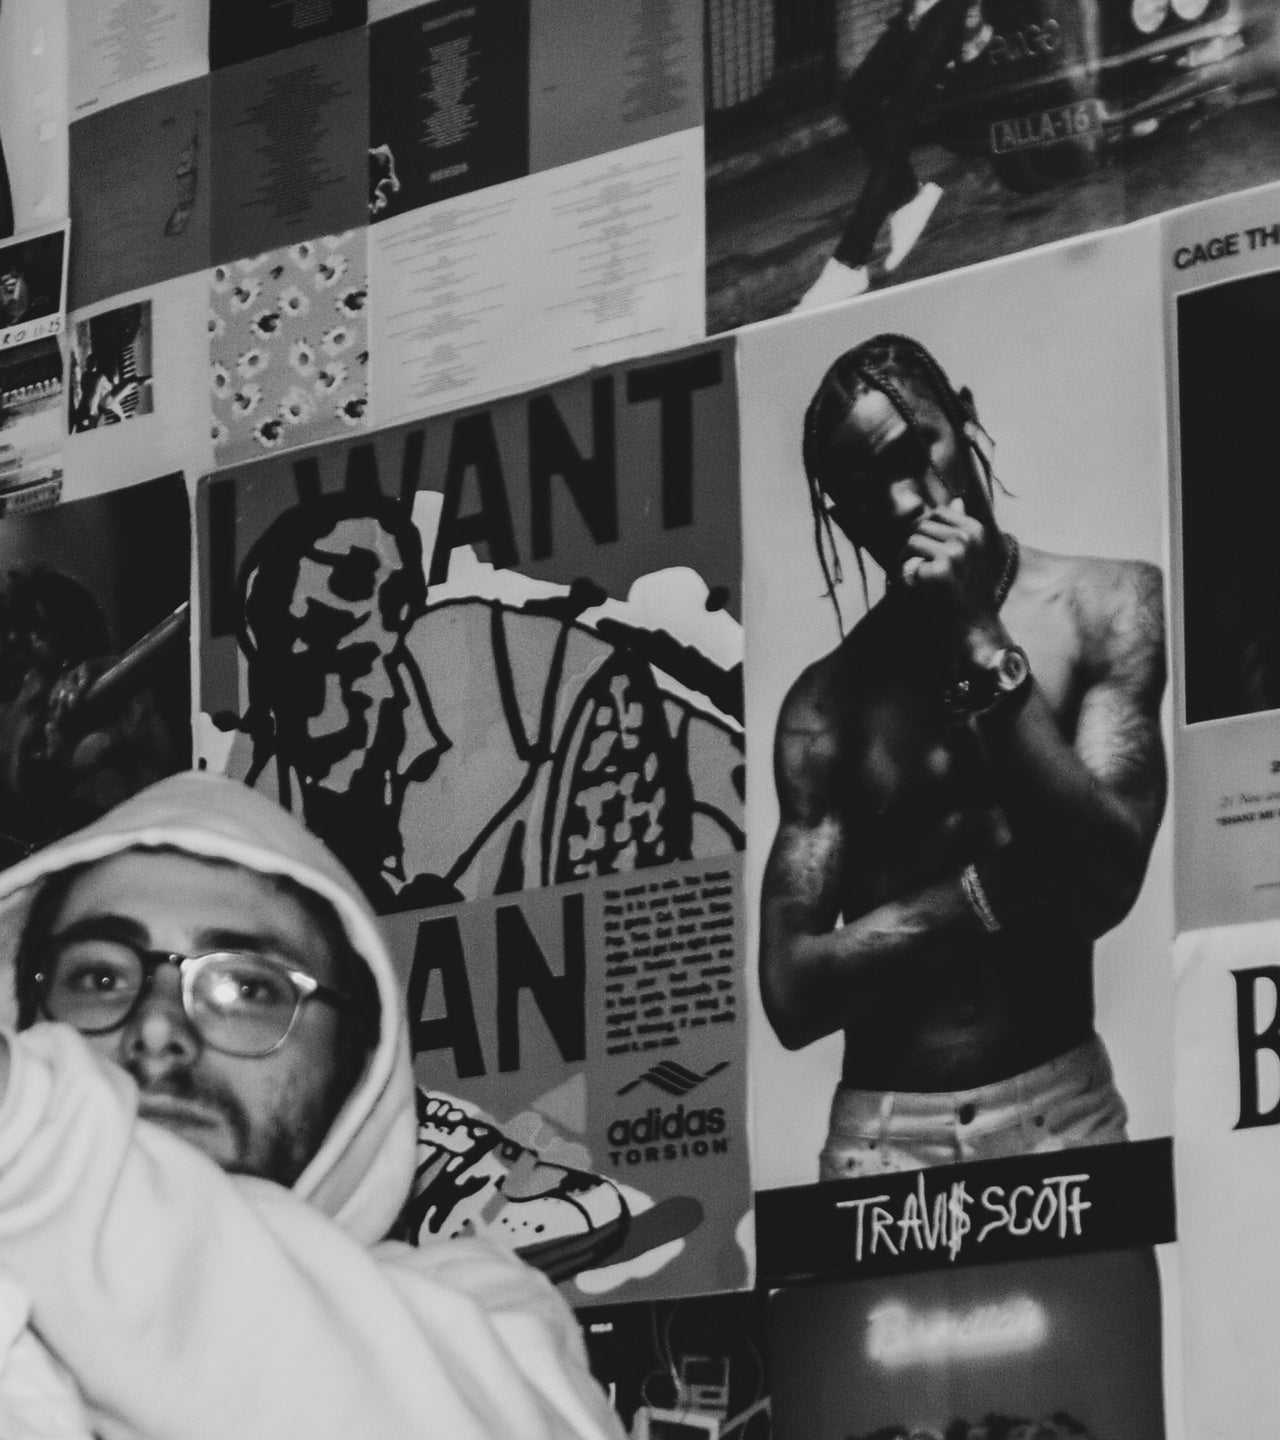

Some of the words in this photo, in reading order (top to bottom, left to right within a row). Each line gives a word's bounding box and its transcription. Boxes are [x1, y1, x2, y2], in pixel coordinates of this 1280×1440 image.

[1173, 232, 1240, 270] CAGE
[607, 1103, 726, 1147] adidas
[609, 1138, 728, 1167] TORSION
[835, 1171, 975, 1263] TRAVI$
[976, 1173, 1092, 1243] SCOTT
